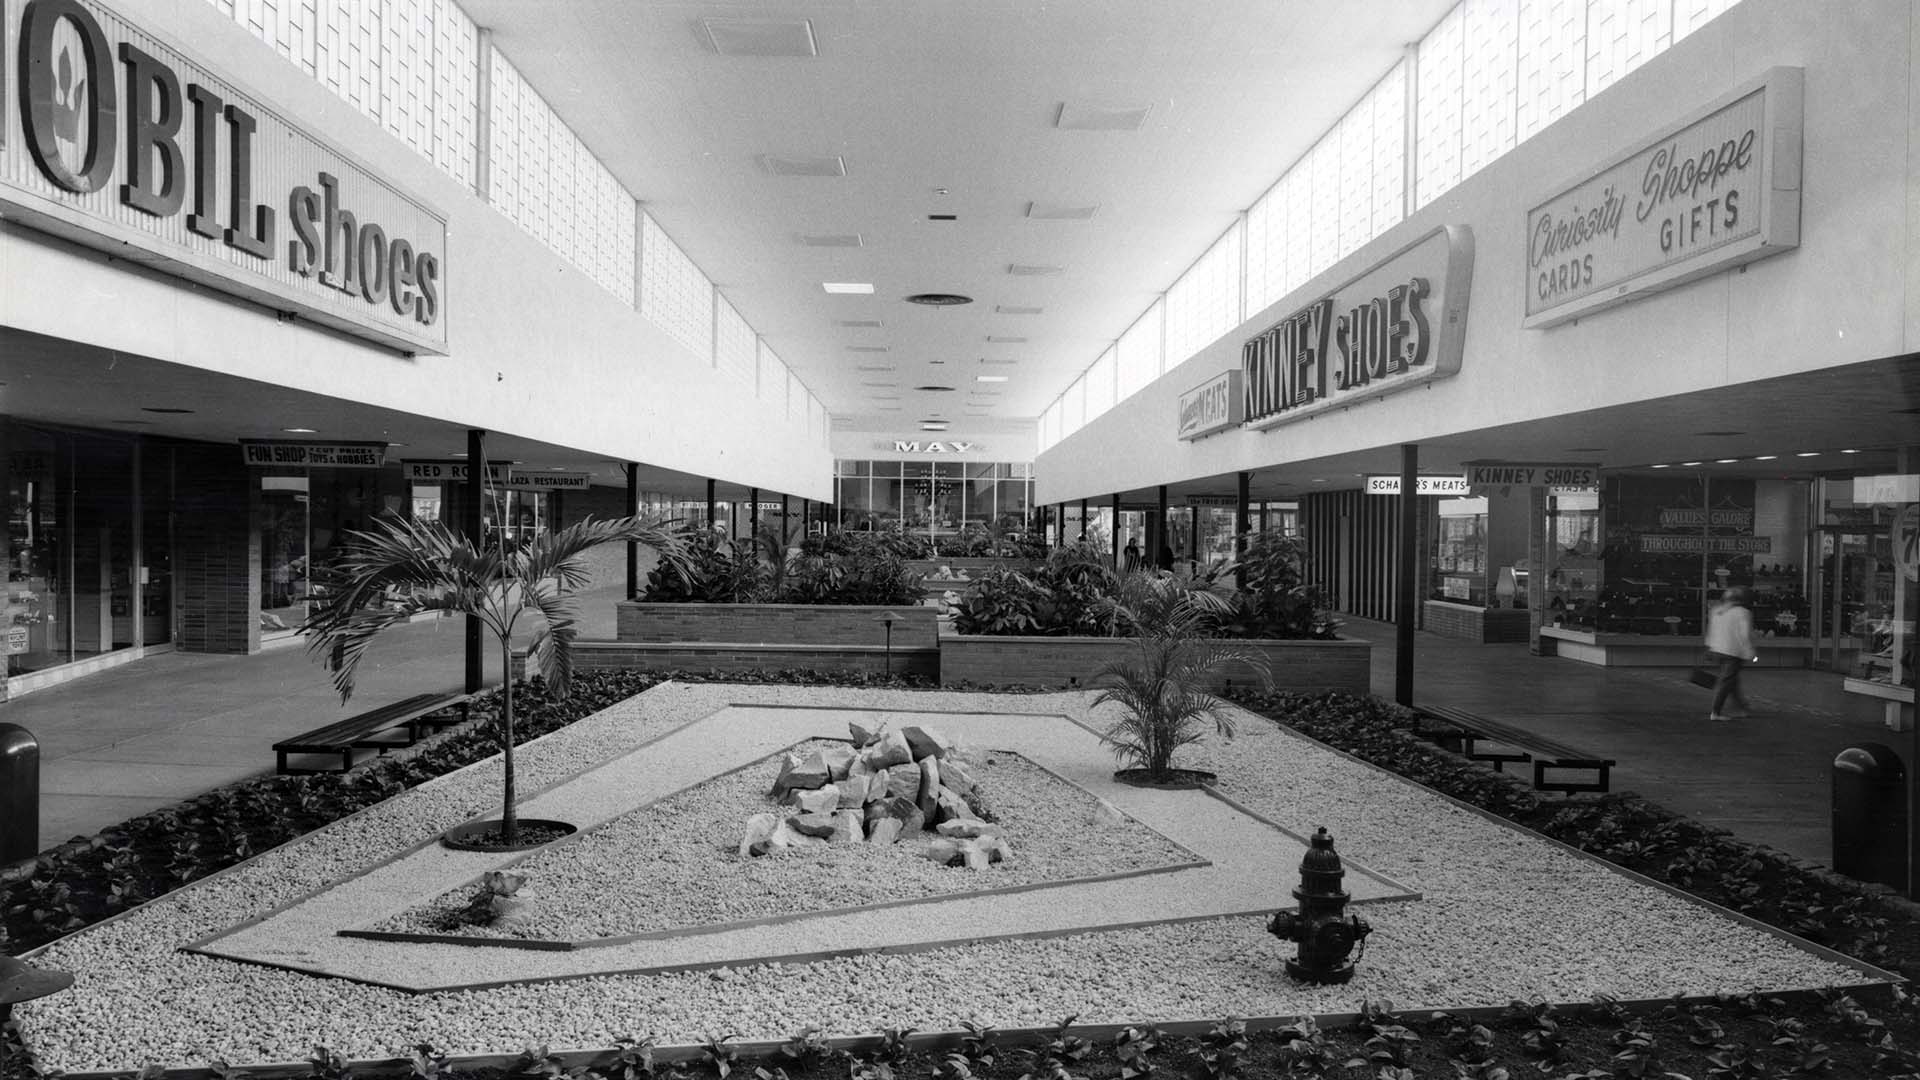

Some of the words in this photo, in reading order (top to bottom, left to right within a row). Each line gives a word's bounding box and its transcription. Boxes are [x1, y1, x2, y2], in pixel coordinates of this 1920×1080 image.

[0, 0, 275, 260] OBIL
[289, 171, 438, 325] shoes
[1531, 184, 1625, 268] Curiosity
[1636, 129, 1755, 223] Shoppe
[1659, 189, 1739, 252] GIFTS
[1538, 253, 1594, 300] CARDS
[1242, 299, 1334, 423] KINNEY
[1335, 277, 1430, 390] SHOES
[248, 445, 272, 462] FUN
[275, 445, 306, 463] SHOP
[894, 440, 974, 453] MAY
[336, 454, 376, 465] HOBBIES
[413, 465, 441, 477] RED
[452, 465, 498, 478] ROIN
[1474, 467, 1536, 485] KINNEY
[1544, 468, 1591, 485] SHOES
[507, 476, 530, 486] LAZA
[534, 477, 585, 487] RESTAURANT
[1372, 479, 1428, 490] SCHAR'S
[1433, 479, 1466, 490] MEATS
